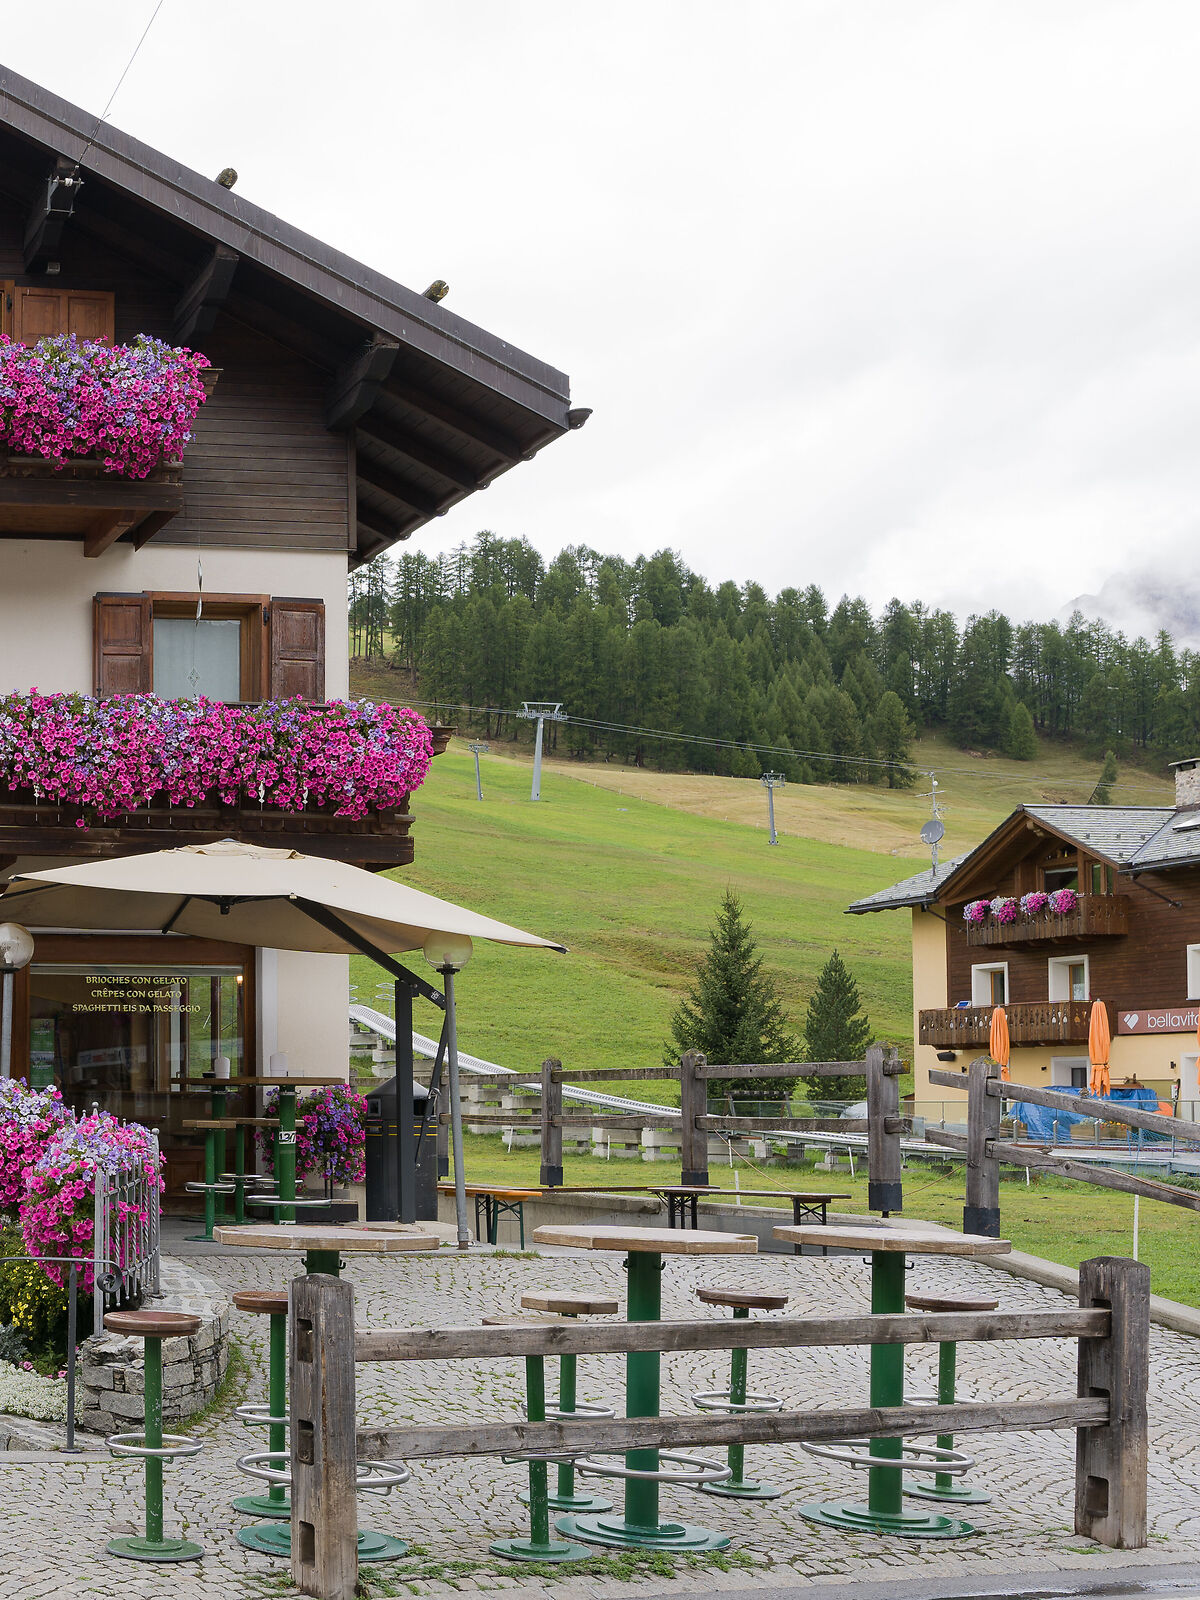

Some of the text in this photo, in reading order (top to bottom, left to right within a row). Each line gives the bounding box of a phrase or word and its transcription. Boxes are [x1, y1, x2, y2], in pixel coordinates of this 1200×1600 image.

[86, 976, 130, 984] BRIOCHES
[91, 988, 124, 998] CRÊPES
[72, 1004, 120, 1012] SPAGHETTI
[153, 1004, 200, 1012] PASSEGGIO
